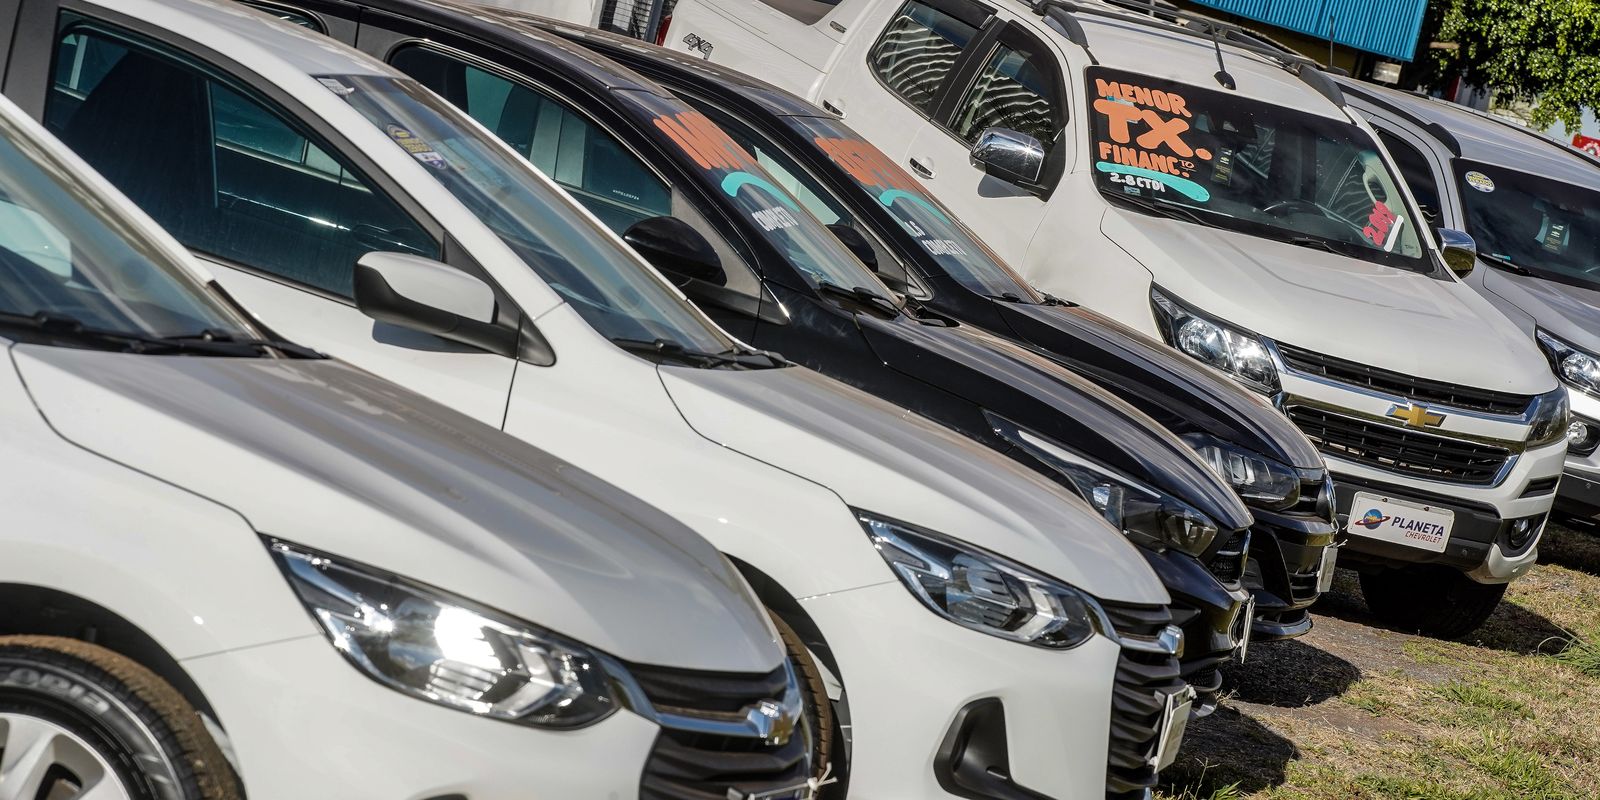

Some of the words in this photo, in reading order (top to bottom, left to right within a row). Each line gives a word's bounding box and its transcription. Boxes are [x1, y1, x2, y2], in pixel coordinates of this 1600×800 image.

[1095, 78, 1192, 118] MENOR
[1093, 98, 1213, 160] TX.
[1392, 516, 1445, 537] PLANETA
[1405, 531, 1442, 544] CHEVROLET
